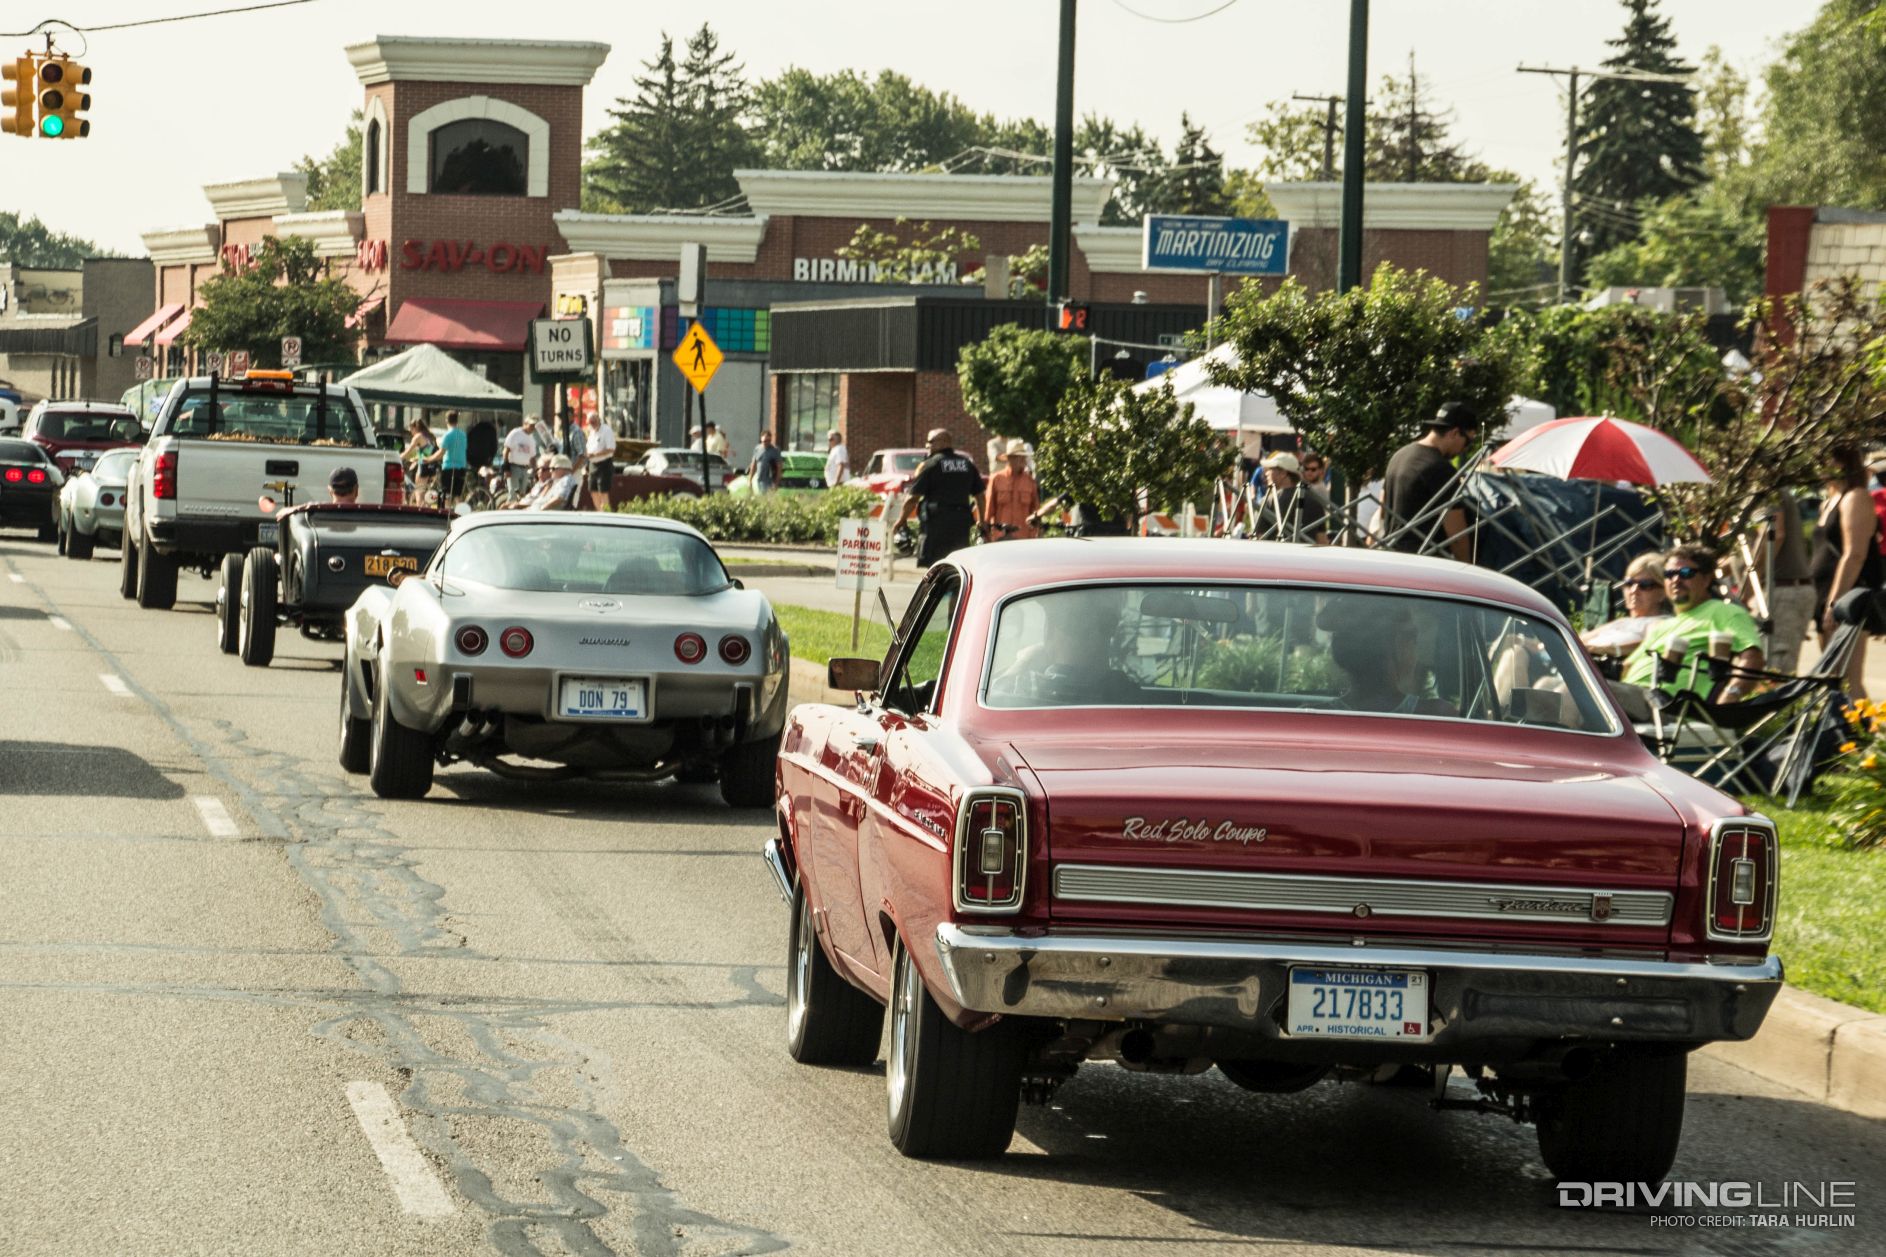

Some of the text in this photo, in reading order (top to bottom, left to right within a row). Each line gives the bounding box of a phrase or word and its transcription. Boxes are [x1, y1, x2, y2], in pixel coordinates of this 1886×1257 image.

[1155, 230, 1276, 260] MARTINIZING
[548, 327, 571, 343] NO
[540, 348, 583, 364] TURNS
[941, 459, 969, 472] POLICE
[857, 527, 870, 538] NO
[842, 539, 882, 552] PARKING
[579, 690, 628, 709] DON 79
[1122, 817, 1267, 846] Red Solo Coupe
[1325, 972, 1423, 985] MICHIGAN 21
[1312, 987, 1403, 1021] 217833
[1296, 1024, 1387, 1036] APR HISTORICAL
